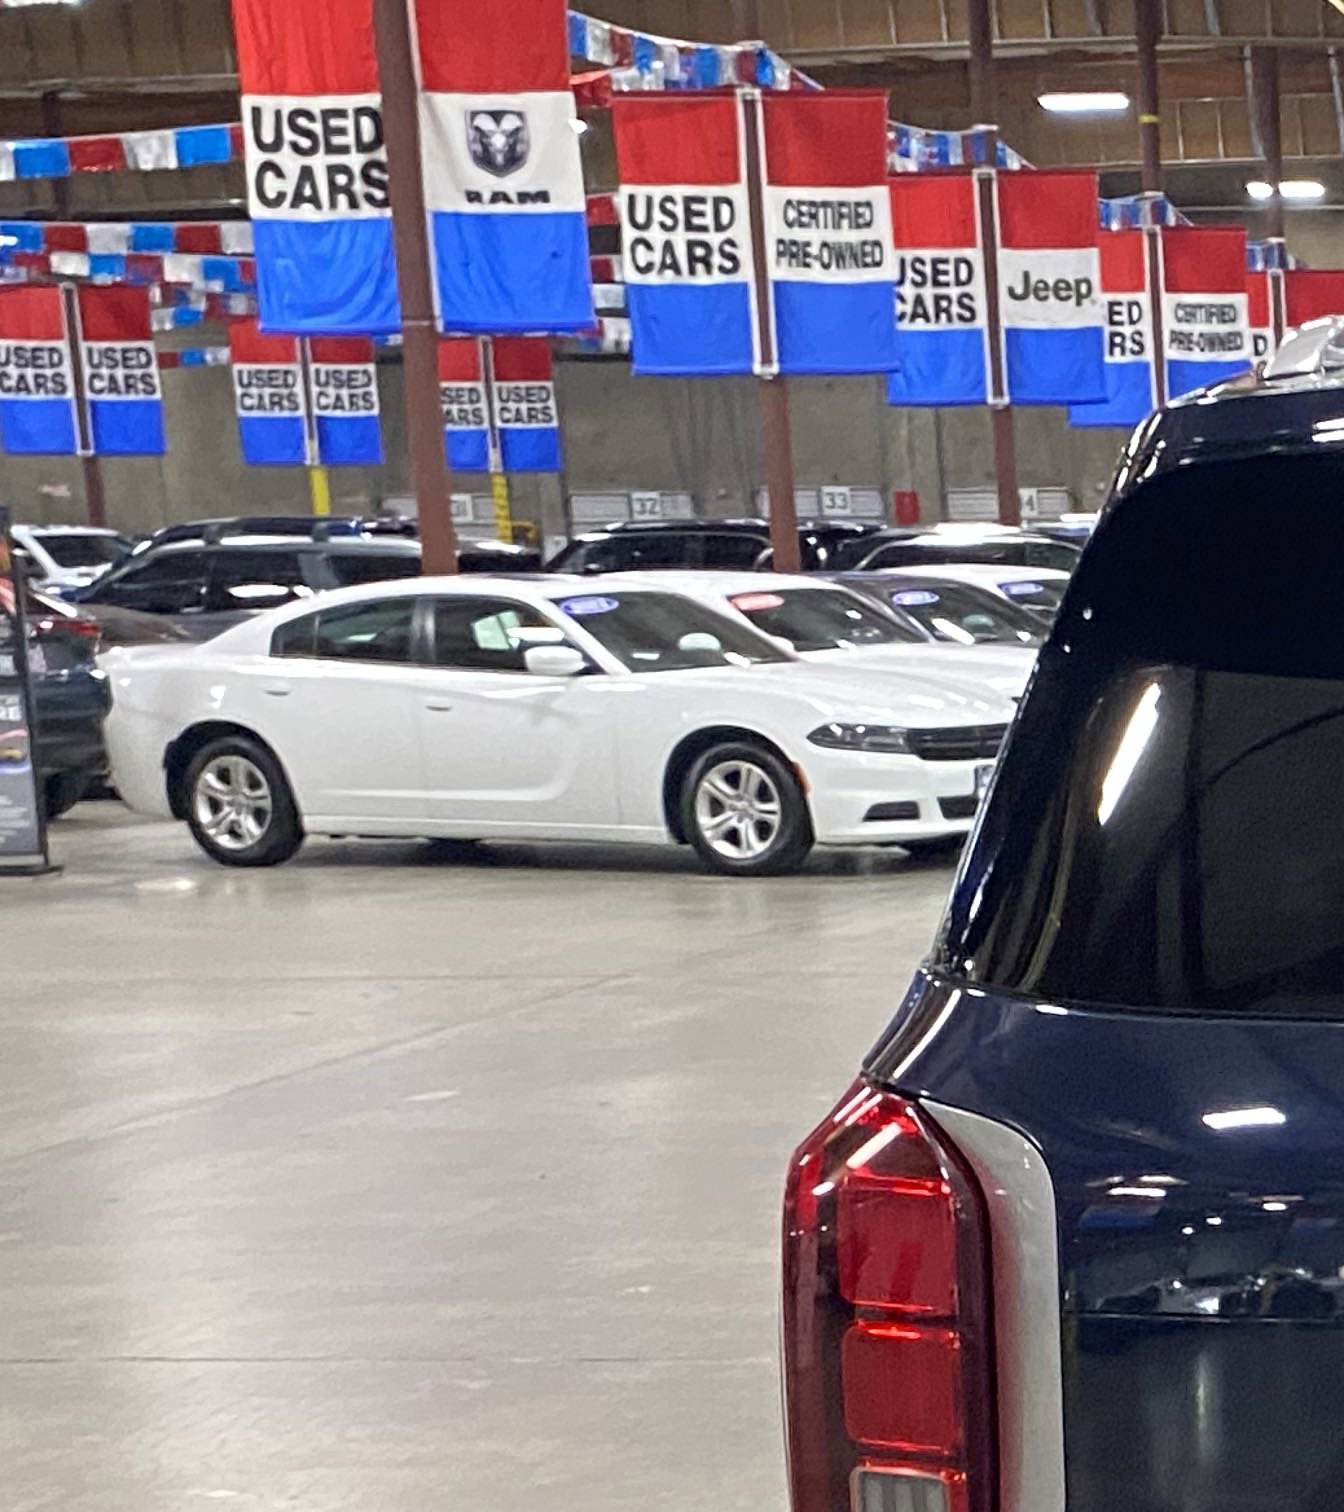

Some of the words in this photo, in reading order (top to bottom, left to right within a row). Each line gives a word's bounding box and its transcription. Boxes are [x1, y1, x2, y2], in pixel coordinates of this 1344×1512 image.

[251, 106, 384, 156] USED
[255, 160, 390, 210] CARS
[465, 190, 550, 204] RAM
[628, 194, 735, 233] USED
[783, 199, 874, 229] CERTIFIED
[630, 237, 741, 276] CARS
[776, 239, 884, 270] PRE-OWNED
[1008, 270, 1093, 307] Jeep
[1107, 300, 1142, 326] ED
[1109, 331, 1145, 356] RS
[87, 347, 152, 369] USED
[88, 373, 156, 395] CARS
[237, 368, 297, 389] USED
[315, 368, 372, 389] USED
[240, 392, 299, 411] CARS
[316, 391, 375, 411] CARS
[441, 387, 481, 405] SED
[497, 386, 551, 403] USED
[445, 407, 484, 425] ARS
[499, 406, 553, 423] CARS
[824, 492, 848, 510] 33
